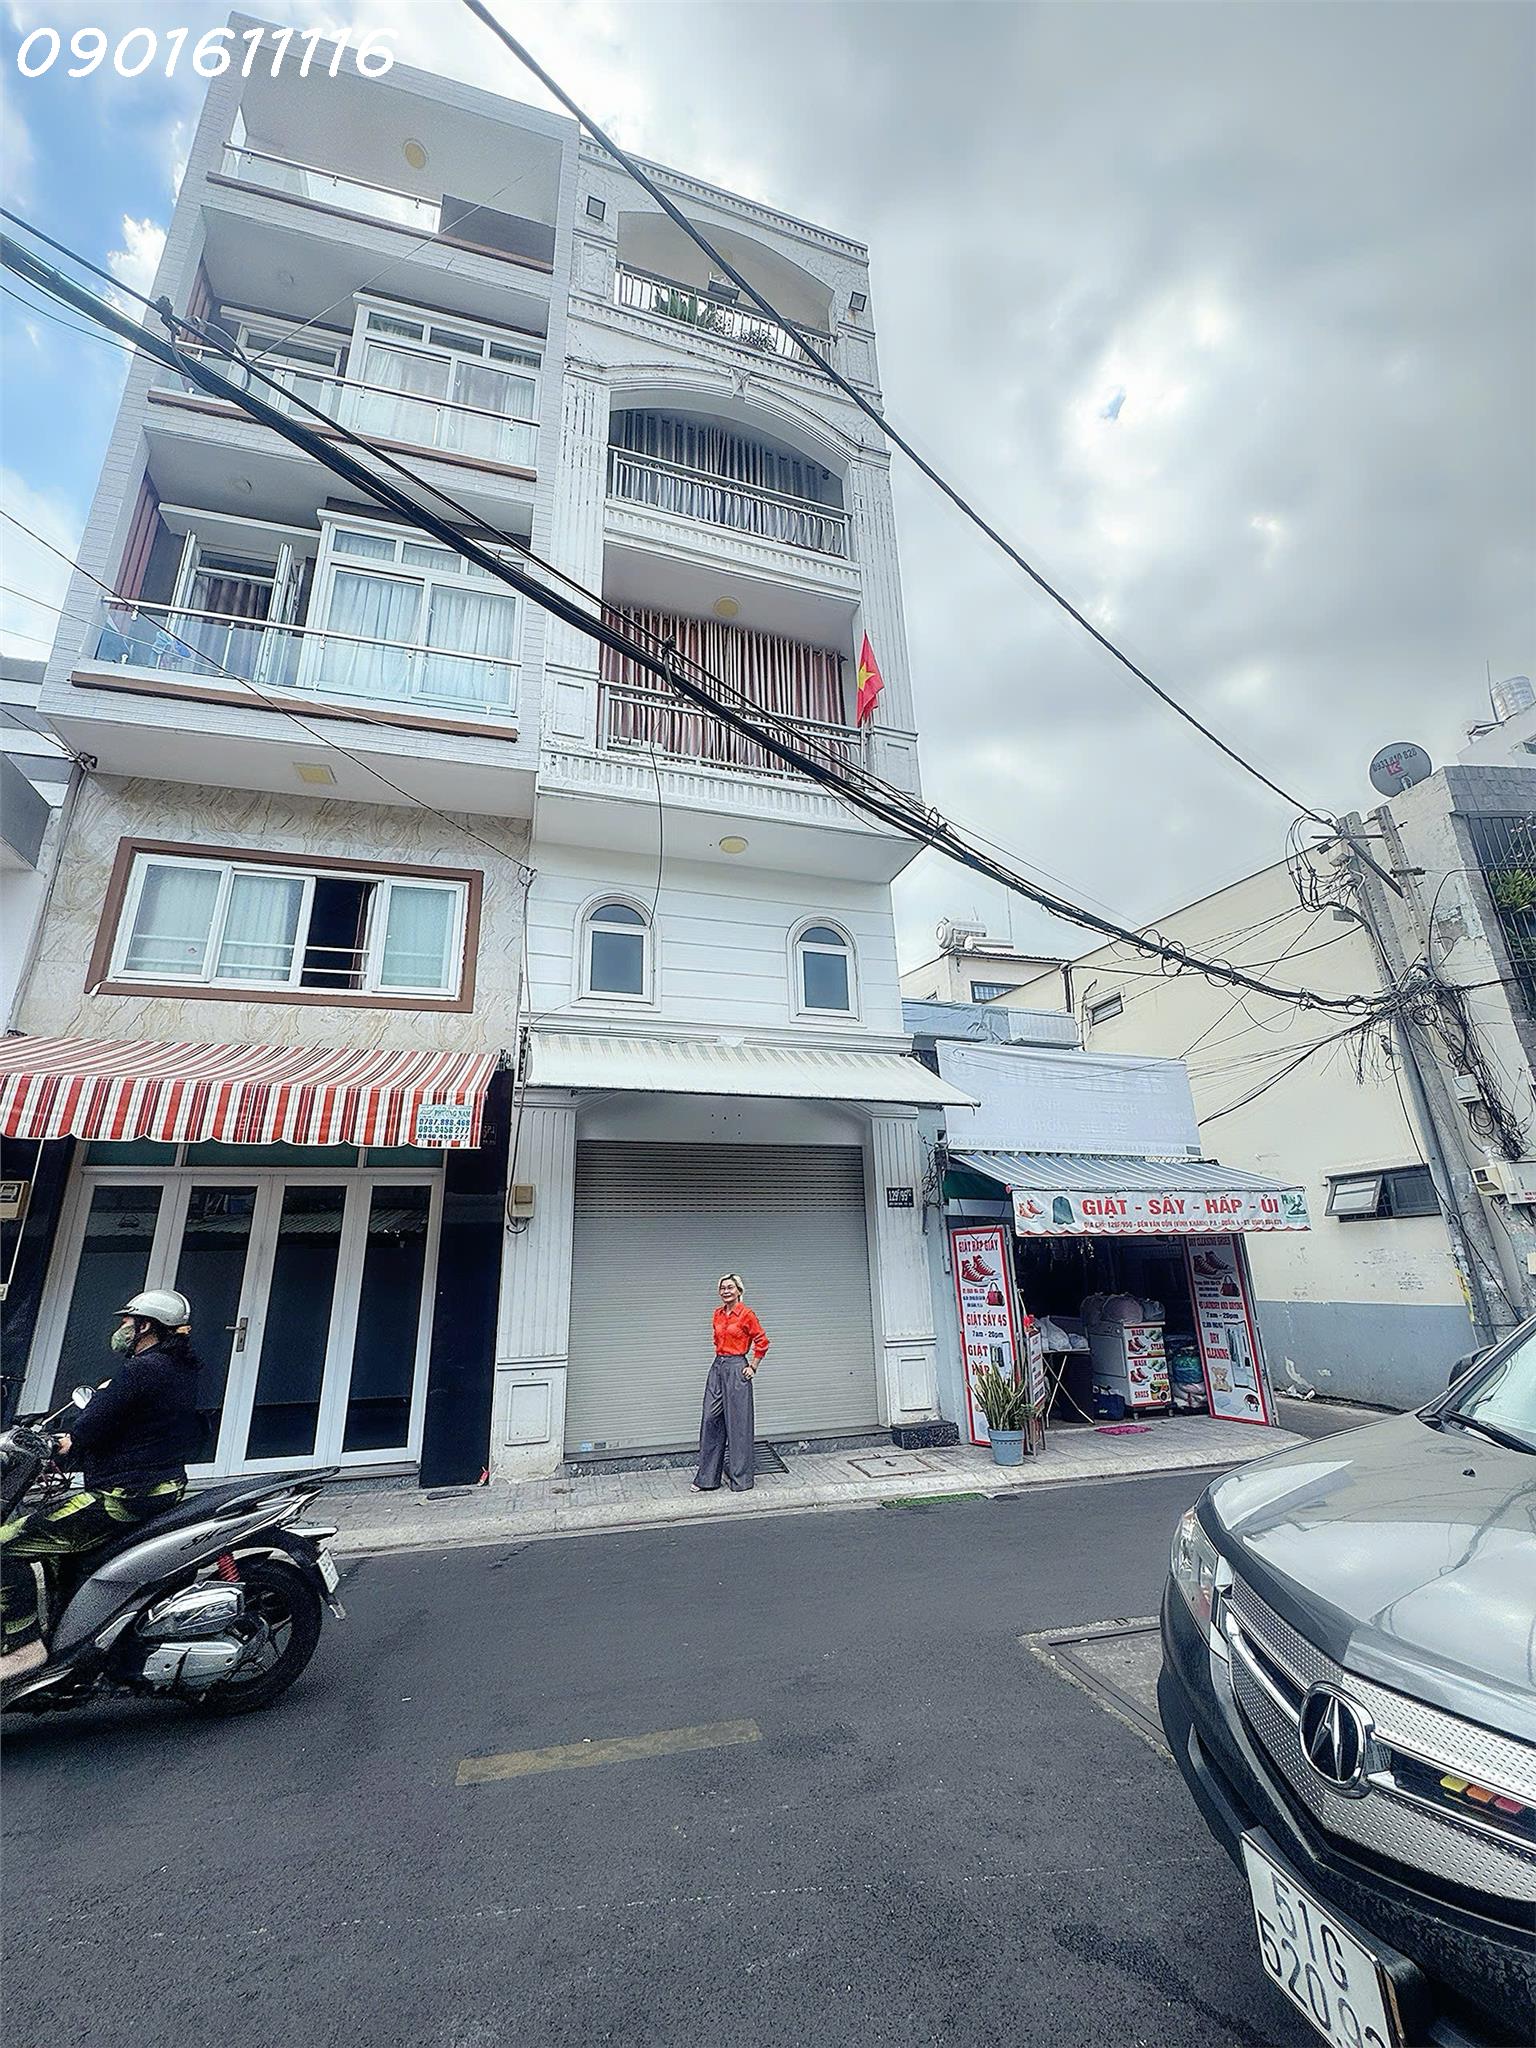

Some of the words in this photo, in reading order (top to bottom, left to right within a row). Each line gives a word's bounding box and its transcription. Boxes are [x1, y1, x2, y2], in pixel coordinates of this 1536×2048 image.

[1082, 1196, 1127, 1219] GIẶT
[1148, 1193, 1185, 1215] SẤY
[1205, 1193, 1242, 1214] HẤP
[1260, 1194, 1280, 1213] ỦI
[966, 1311, 981, 1328] GIẶT
[982, 1310, 996, 1326] SẤY
[968, 1343, 988, 1358] GIẶT
[1270, 1871, 1349, 1992] 51G
